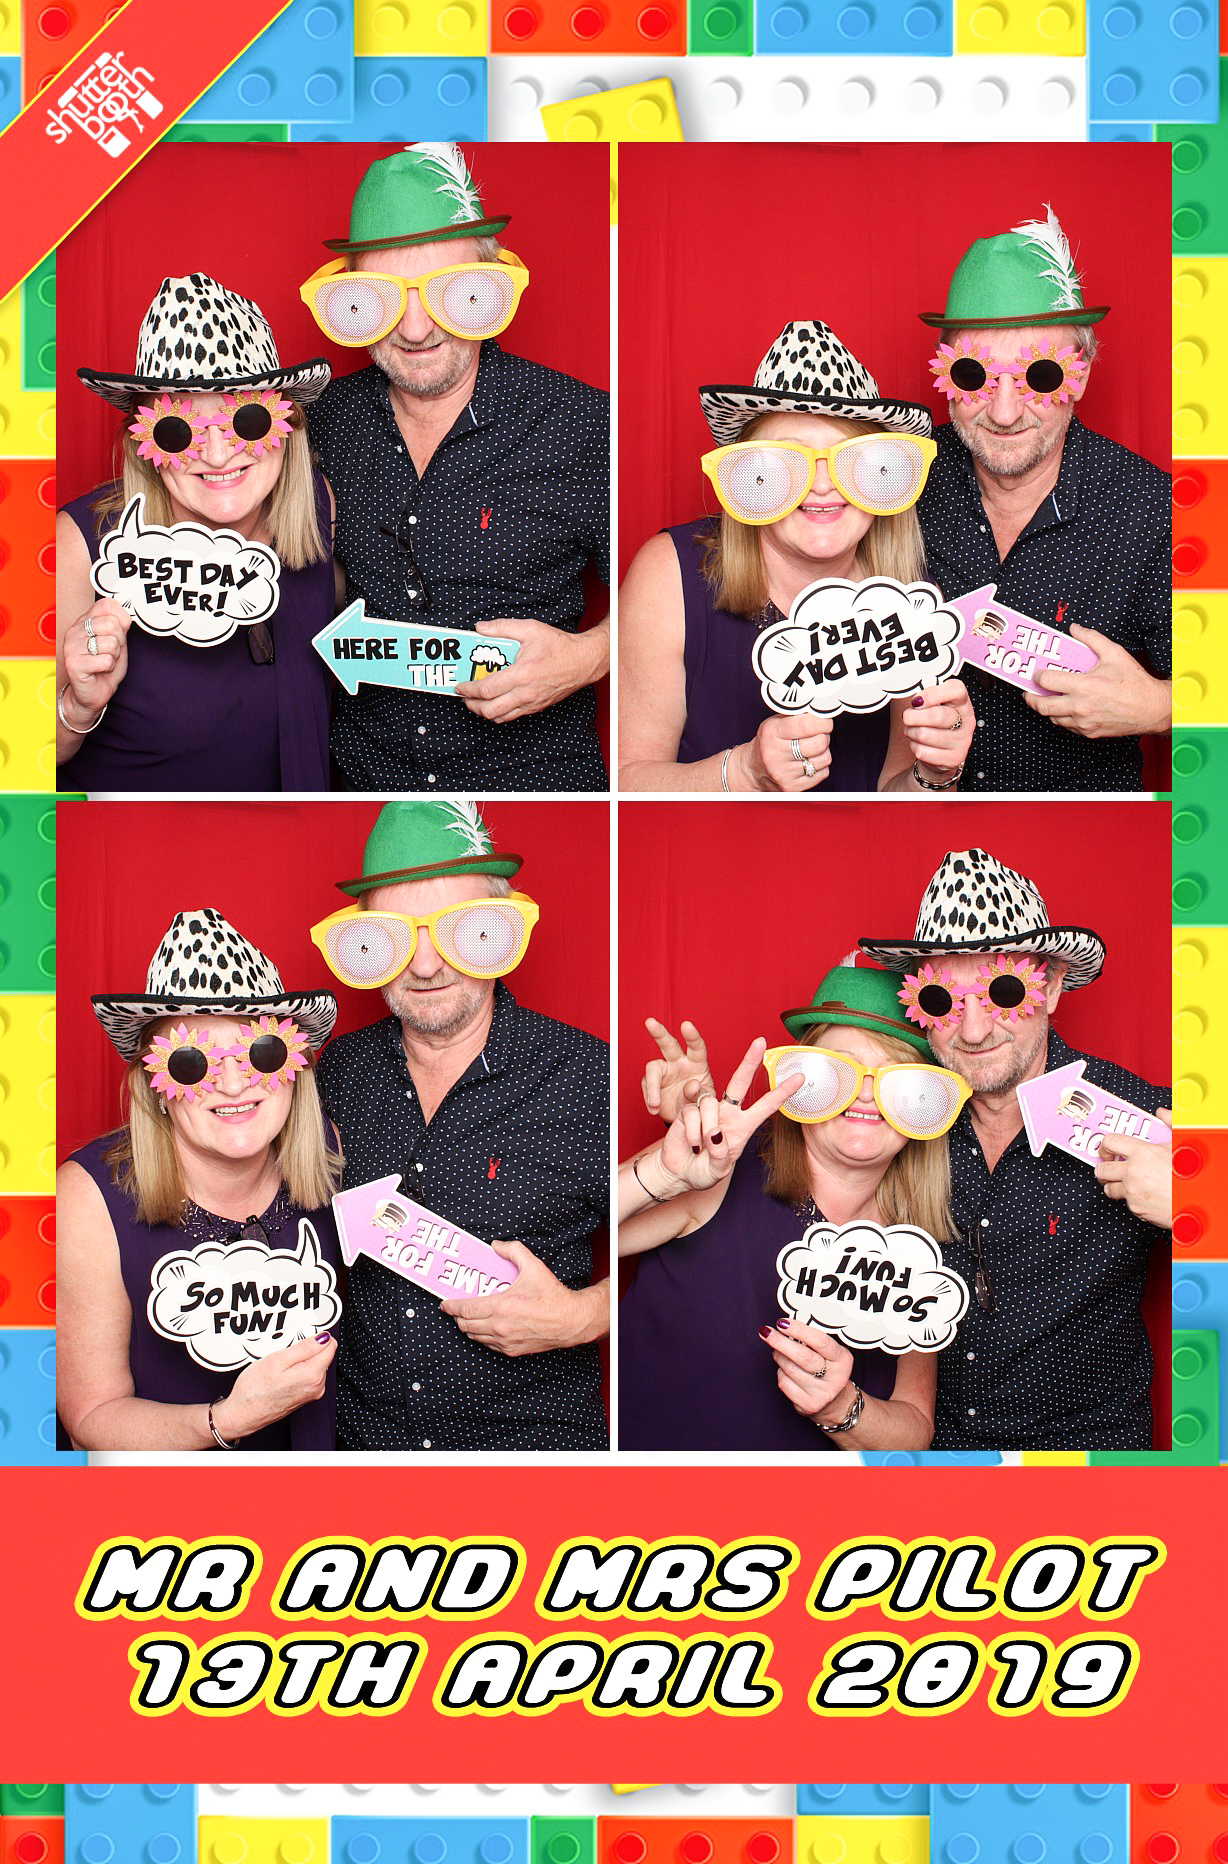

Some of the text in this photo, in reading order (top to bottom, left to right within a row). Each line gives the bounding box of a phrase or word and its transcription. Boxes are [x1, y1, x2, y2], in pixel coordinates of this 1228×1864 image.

[117, 552, 259, 590] BEST DAY
[144, 582, 229, 617] EVER!
[333, 638, 462, 661] HERE FOR
[807, 612, 904, 656] EVER!
[1011, 624, 1061, 661] THE
[407, 664, 459, 687] THE
[782, 631, 939, 688] BEST DAY
[984, 643, 1037, 680] FOR
[1098, 1104, 1151, 1143] THE
[381, 1235, 435, 1277] FOR
[411, 1218, 461, 1259] THE
[835, 1246, 912, 1289] FUN!
[231, 1281, 320, 1311] MUCH
[795, 1266, 890, 1313] MUCH
[213, 1310, 287, 1340] FUN!
